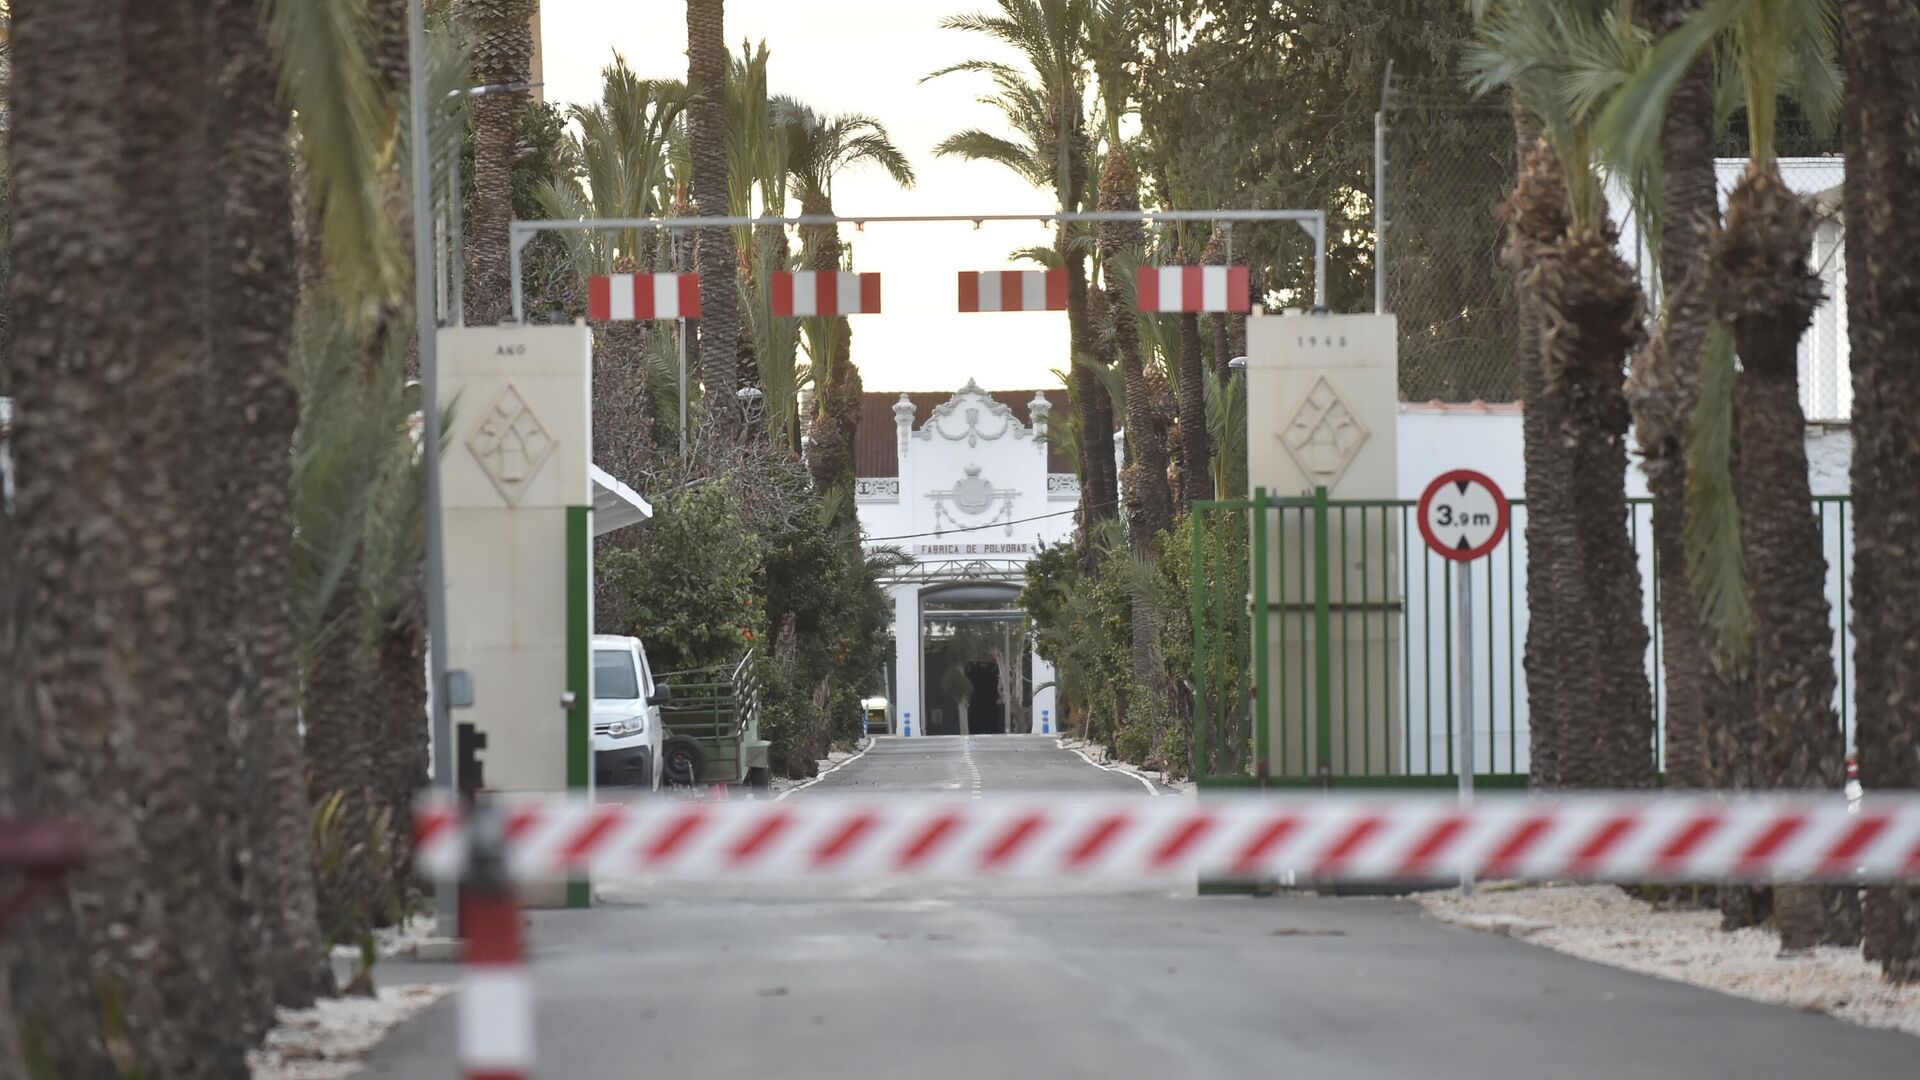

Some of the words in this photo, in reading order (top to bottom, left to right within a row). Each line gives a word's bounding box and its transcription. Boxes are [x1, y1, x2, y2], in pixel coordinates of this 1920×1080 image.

[921, 544, 959, 554] FABRICA
[966, 544, 977, 554] DE
[984, 543, 1027, 553] POLVORAS
